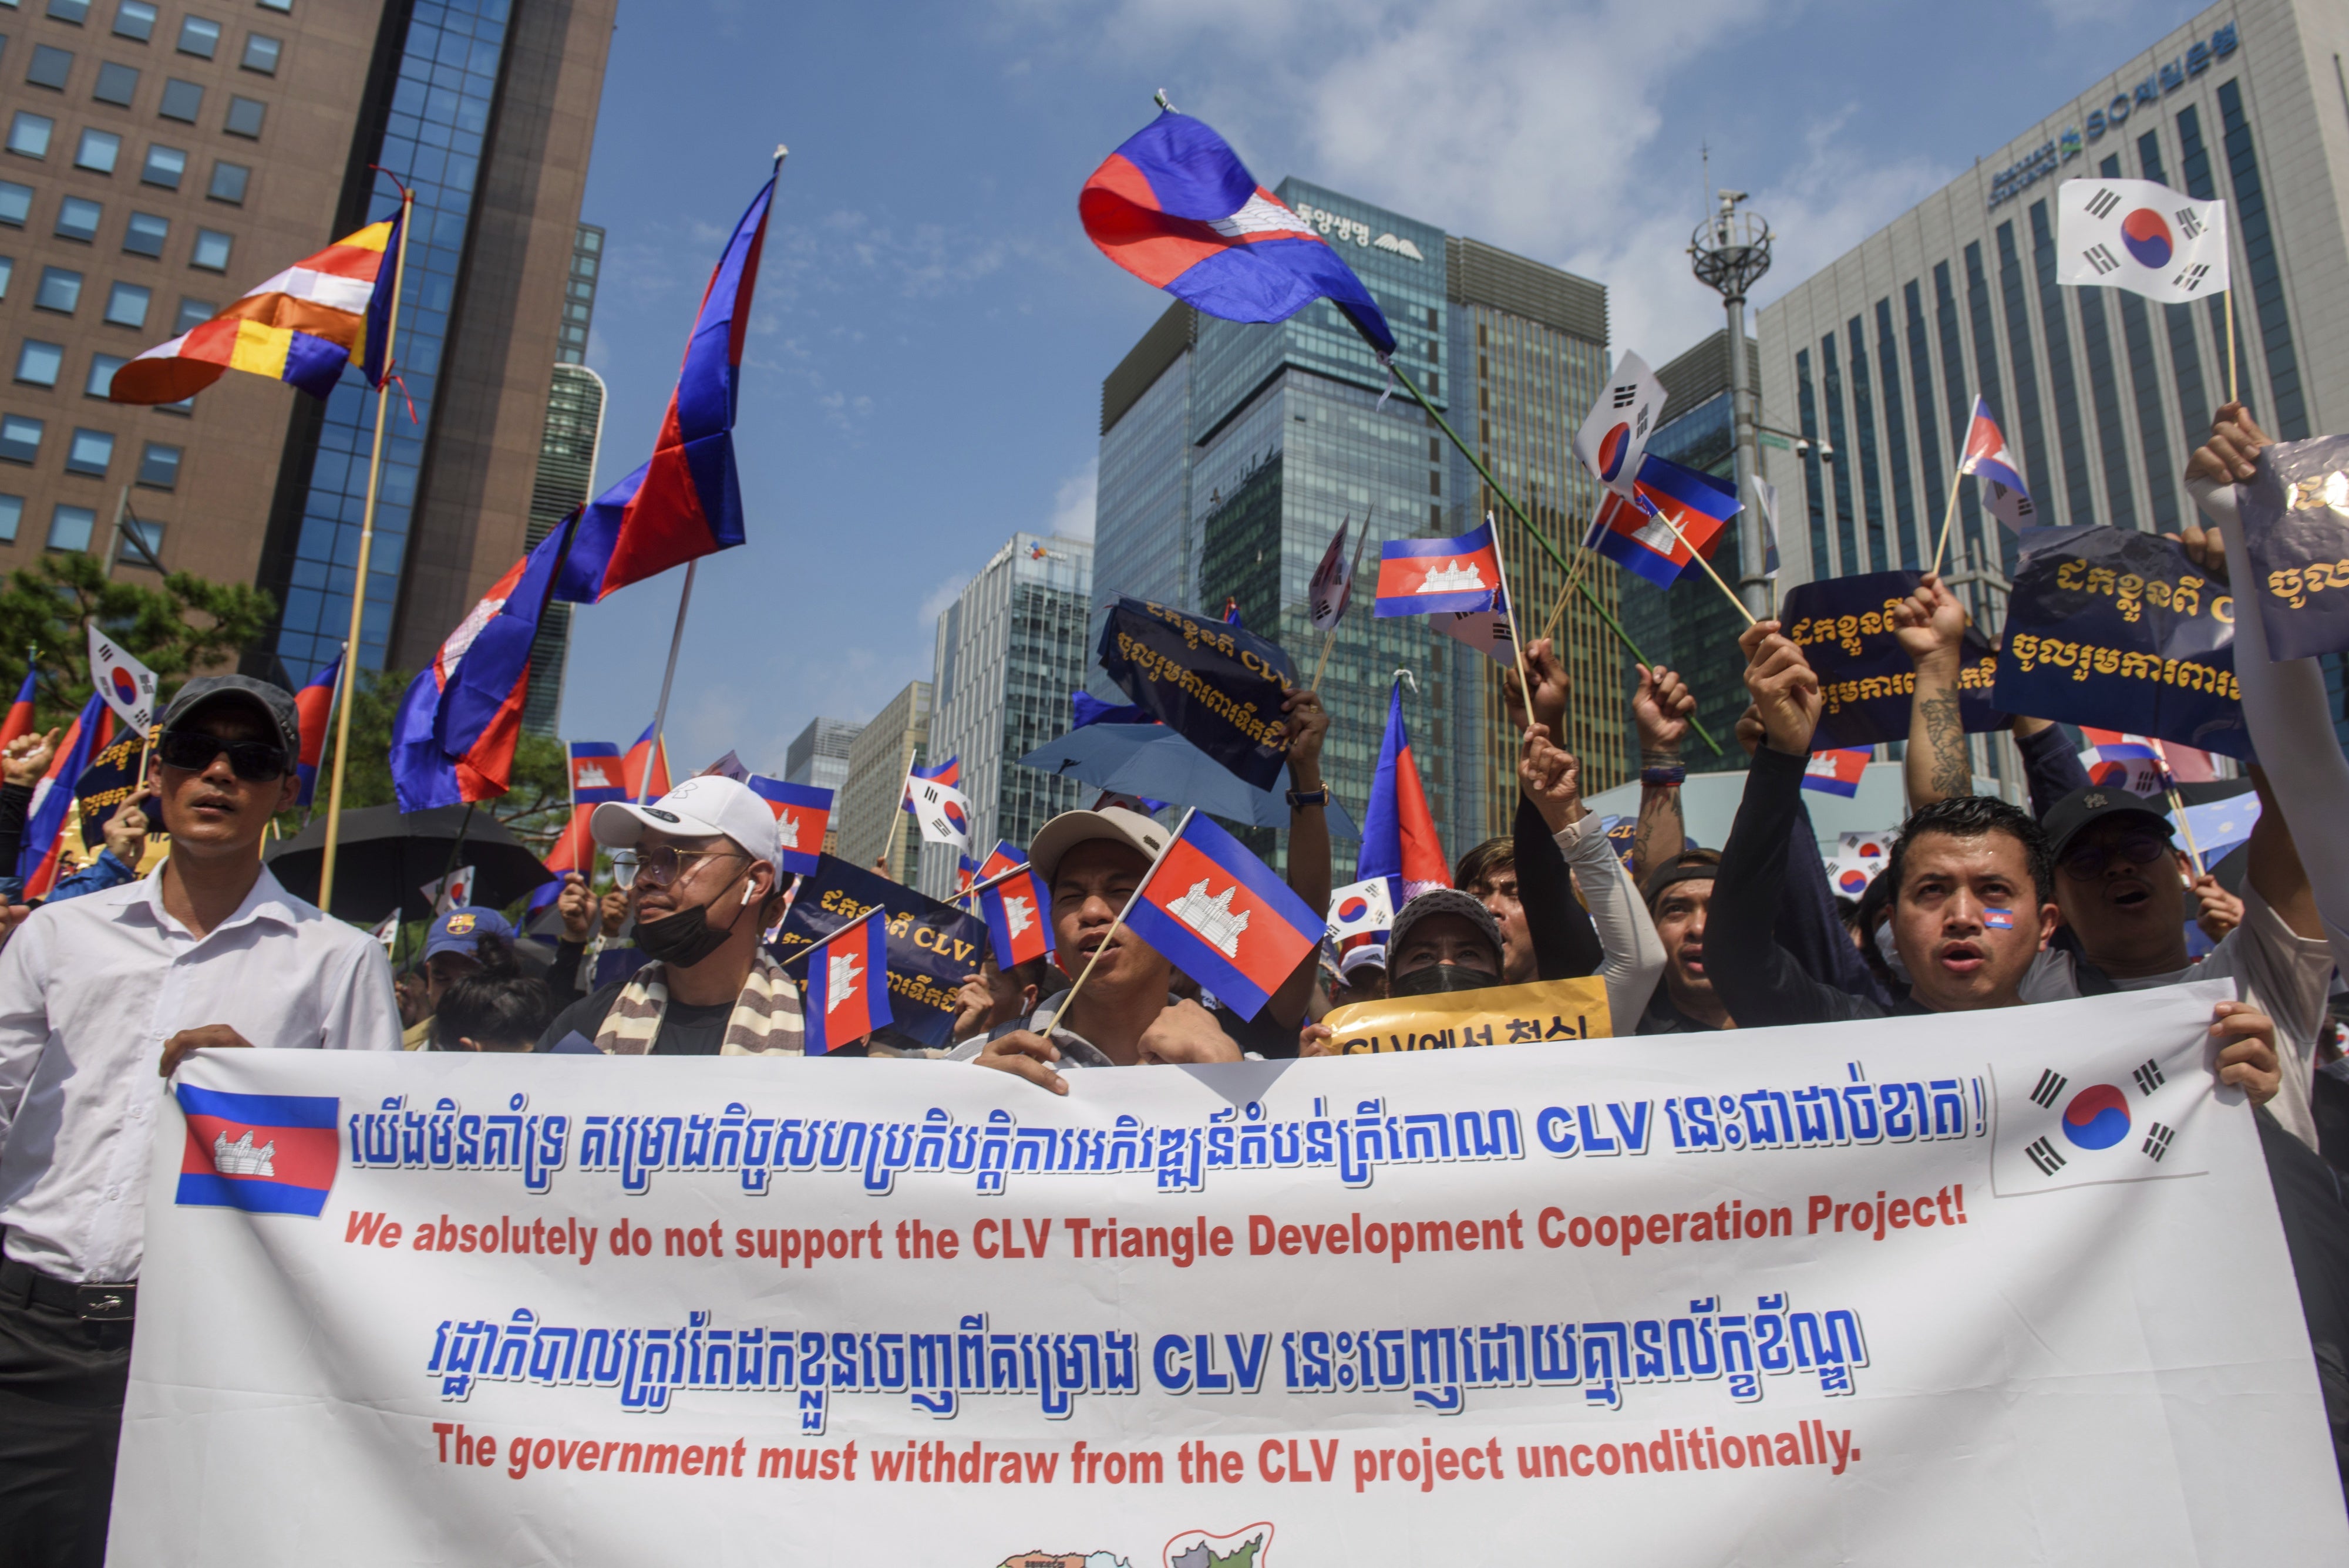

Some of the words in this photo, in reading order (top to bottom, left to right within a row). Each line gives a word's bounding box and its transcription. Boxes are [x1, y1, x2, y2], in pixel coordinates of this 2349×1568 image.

[2087, 21, 2239, 138] SC제일은행
[1296, 203, 1370, 247] 동양생명
[914, 927, 977, 967] CLV.
[1537, 1102, 1648, 1153] CLV
[345, 1211, 403, 1249] We
[413, 1214, 598, 1266] absolutely
[611, 1218, 652, 1257] do
[665, 1220, 723, 1259] not
[736, 1220, 883, 1269] support
[896, 1219, 960, 1260] the
[973, 1218, 1052, 1260] CLV
[1065, 1216, 1234, 1268] Triangle
[1249, 1210, 1525, 1264] Development
[1538, 1200, 1793, 1256] Cooperation
[1809, 1184, 1968, 1241] Project!
[1153, 1334, 1267, 1389] CLV
[433, 1422, 497, 1468] The
[509, 1437, 746, 1480] government
[758, 1441, 858, 1481] must
[872, 1440, 1059, 1484] withdraw
[1072, 1441, 1163, 1485] from
[1179, 1441, 1244, 1484] the
[1258, 1439, 1340, 1483] CLV
[1354, 1436, 1505, 1493] project
[1517, 1419, 1860, 1479] unconditionally.
